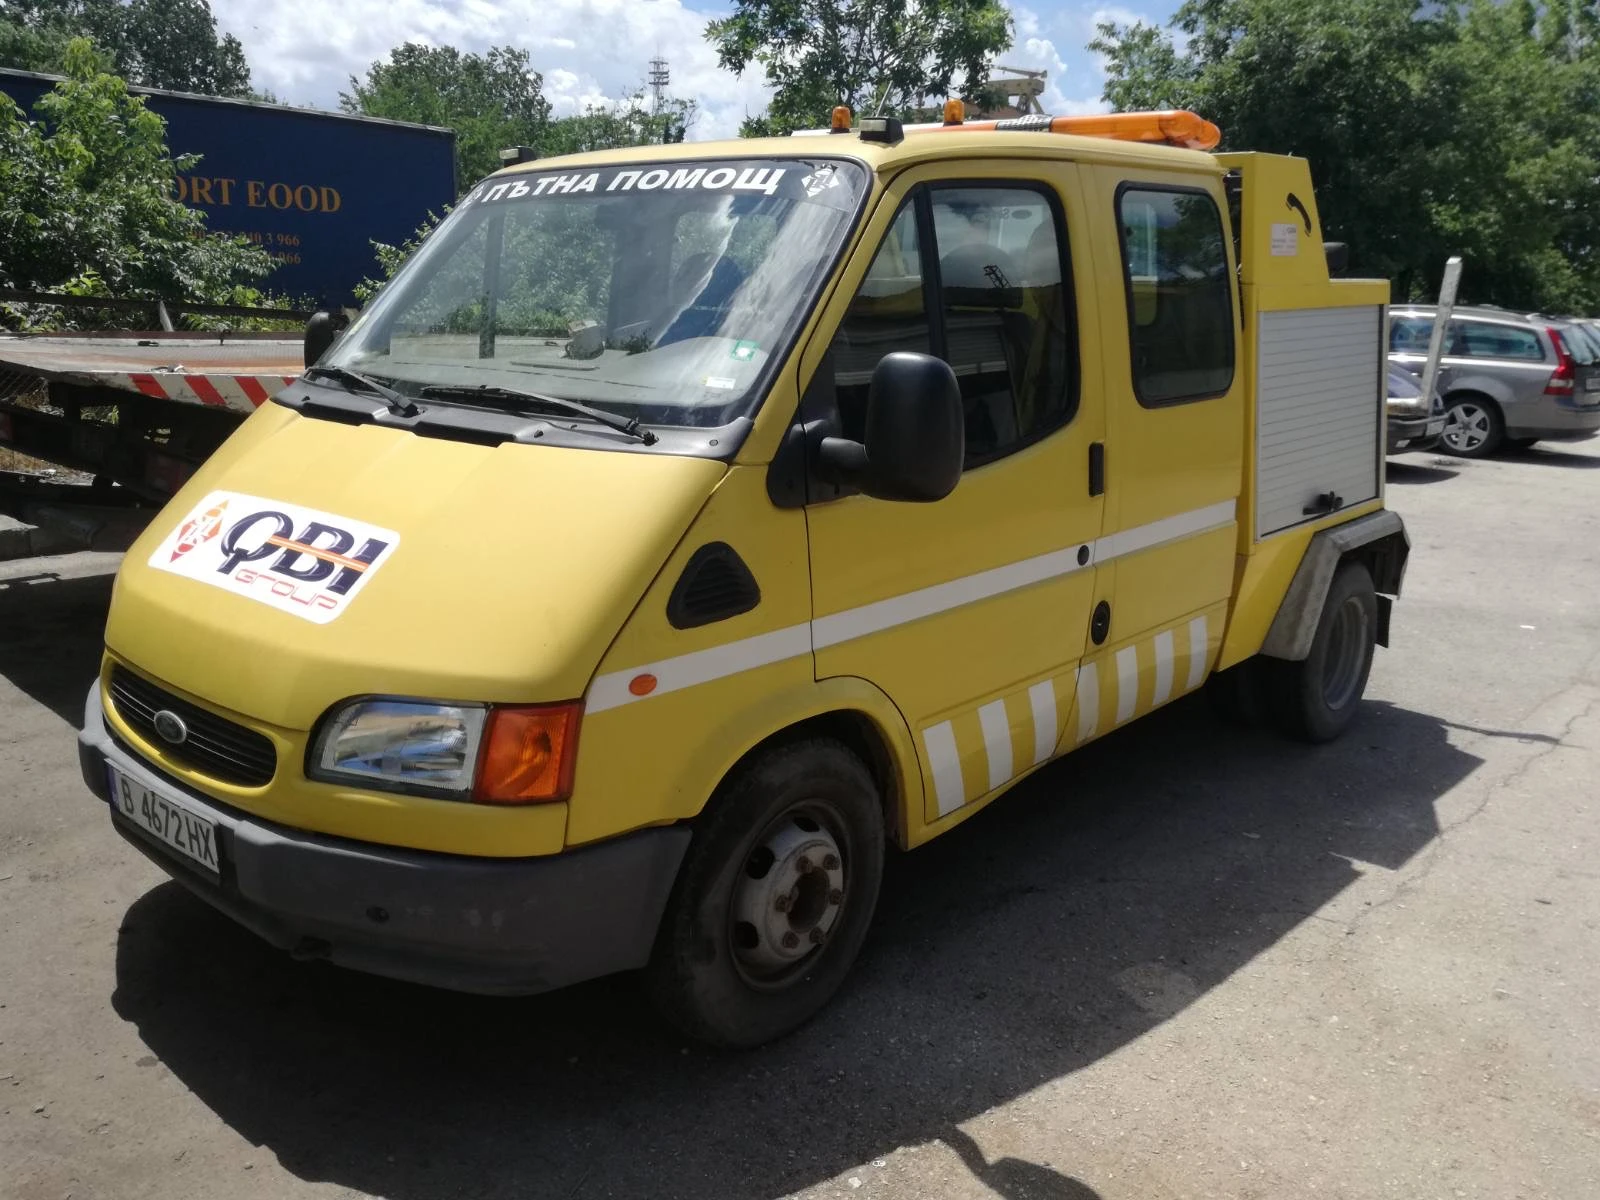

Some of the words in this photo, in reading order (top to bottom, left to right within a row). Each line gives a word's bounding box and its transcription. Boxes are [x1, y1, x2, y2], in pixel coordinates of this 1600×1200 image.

[246, 180, 342, 213] EOOD
[481, 173, 600, 203] ПЪТНА
[605, 167, 786, 195] ПОМОЩ
[276, 232, 300, 247] 966
[216, 510, 389, 596] QBI
